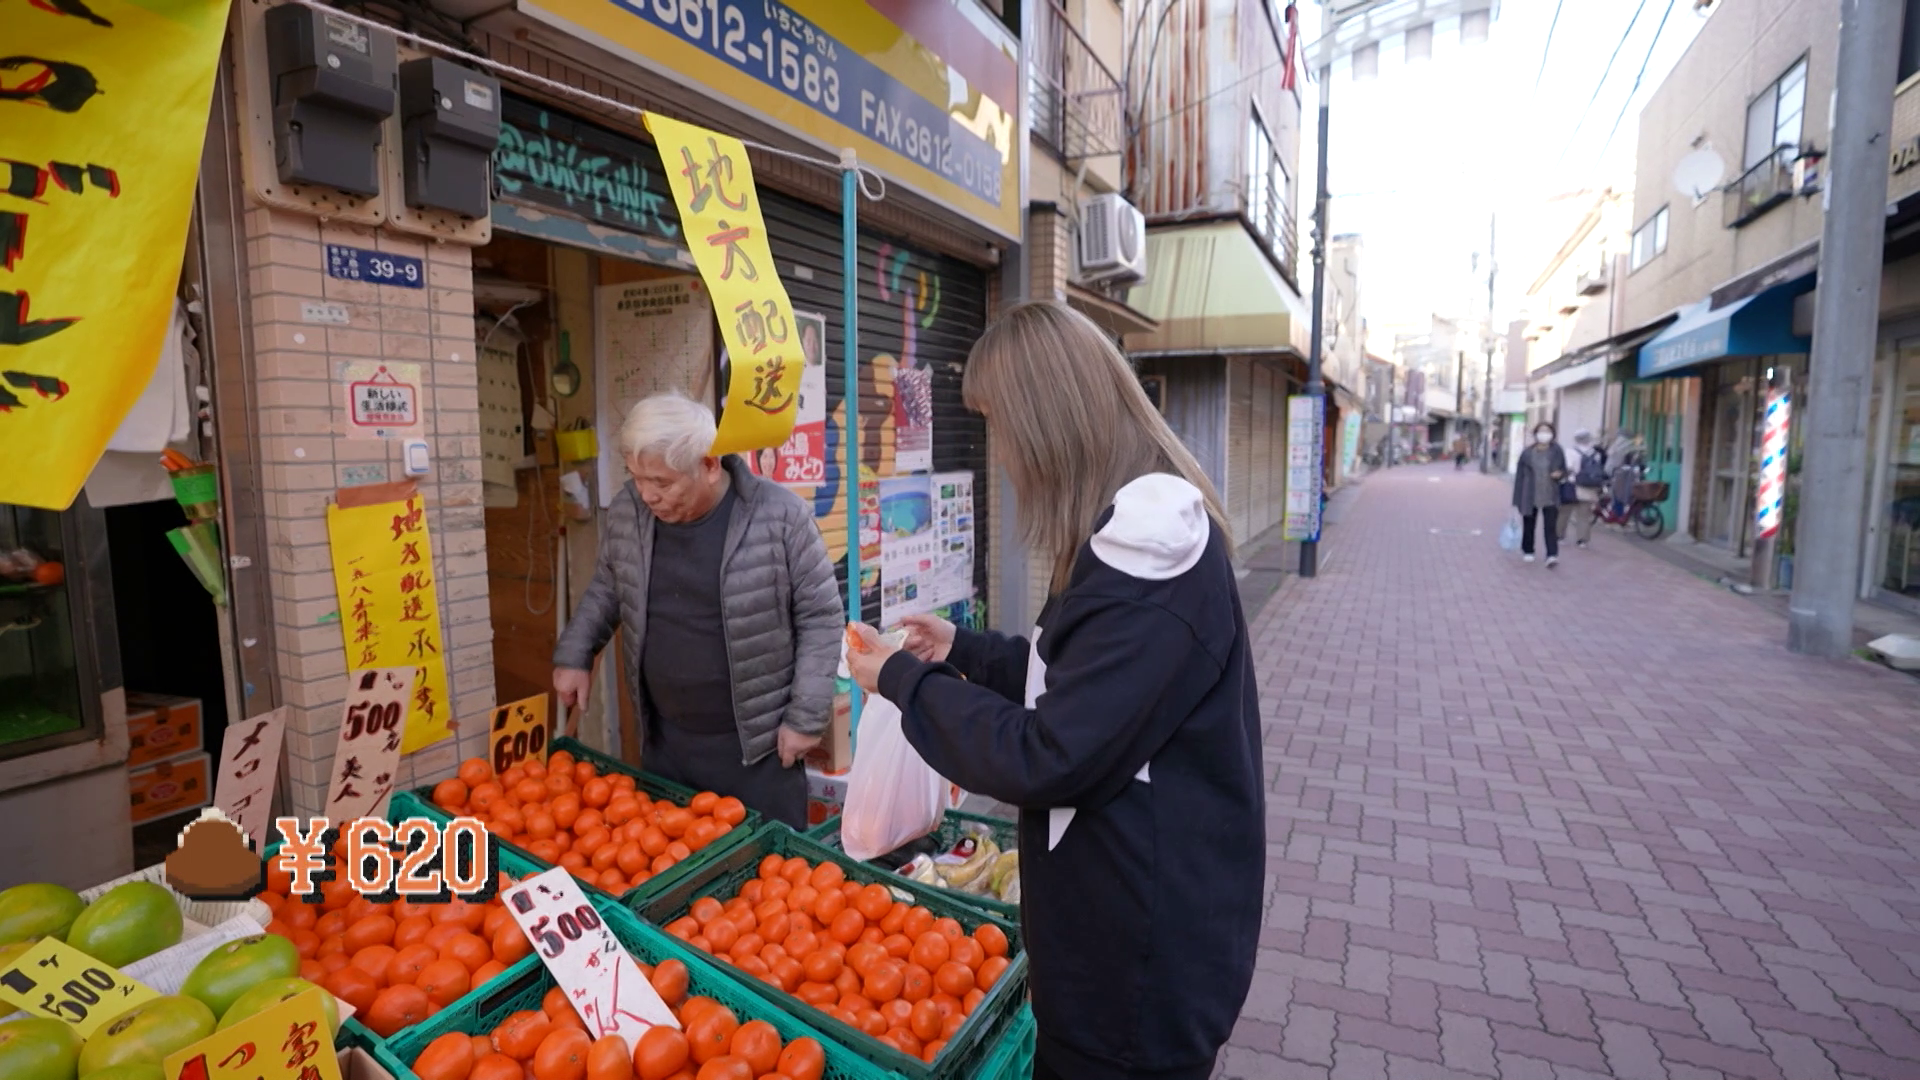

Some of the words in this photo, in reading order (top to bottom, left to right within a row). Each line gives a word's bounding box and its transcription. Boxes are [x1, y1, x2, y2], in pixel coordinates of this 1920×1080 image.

[861, 89, 903, 150] FAX
[370, 258, 417, 281] 39-9
[681, 136, 794, 415] 地方配送
[785, 457, 824, 480] みどり
[342, 700, 402, 742] 500
[494, 724, 545, 775] 600
[530, 904, 602, 959] 500
[39, 967, 116, 1024] 500
